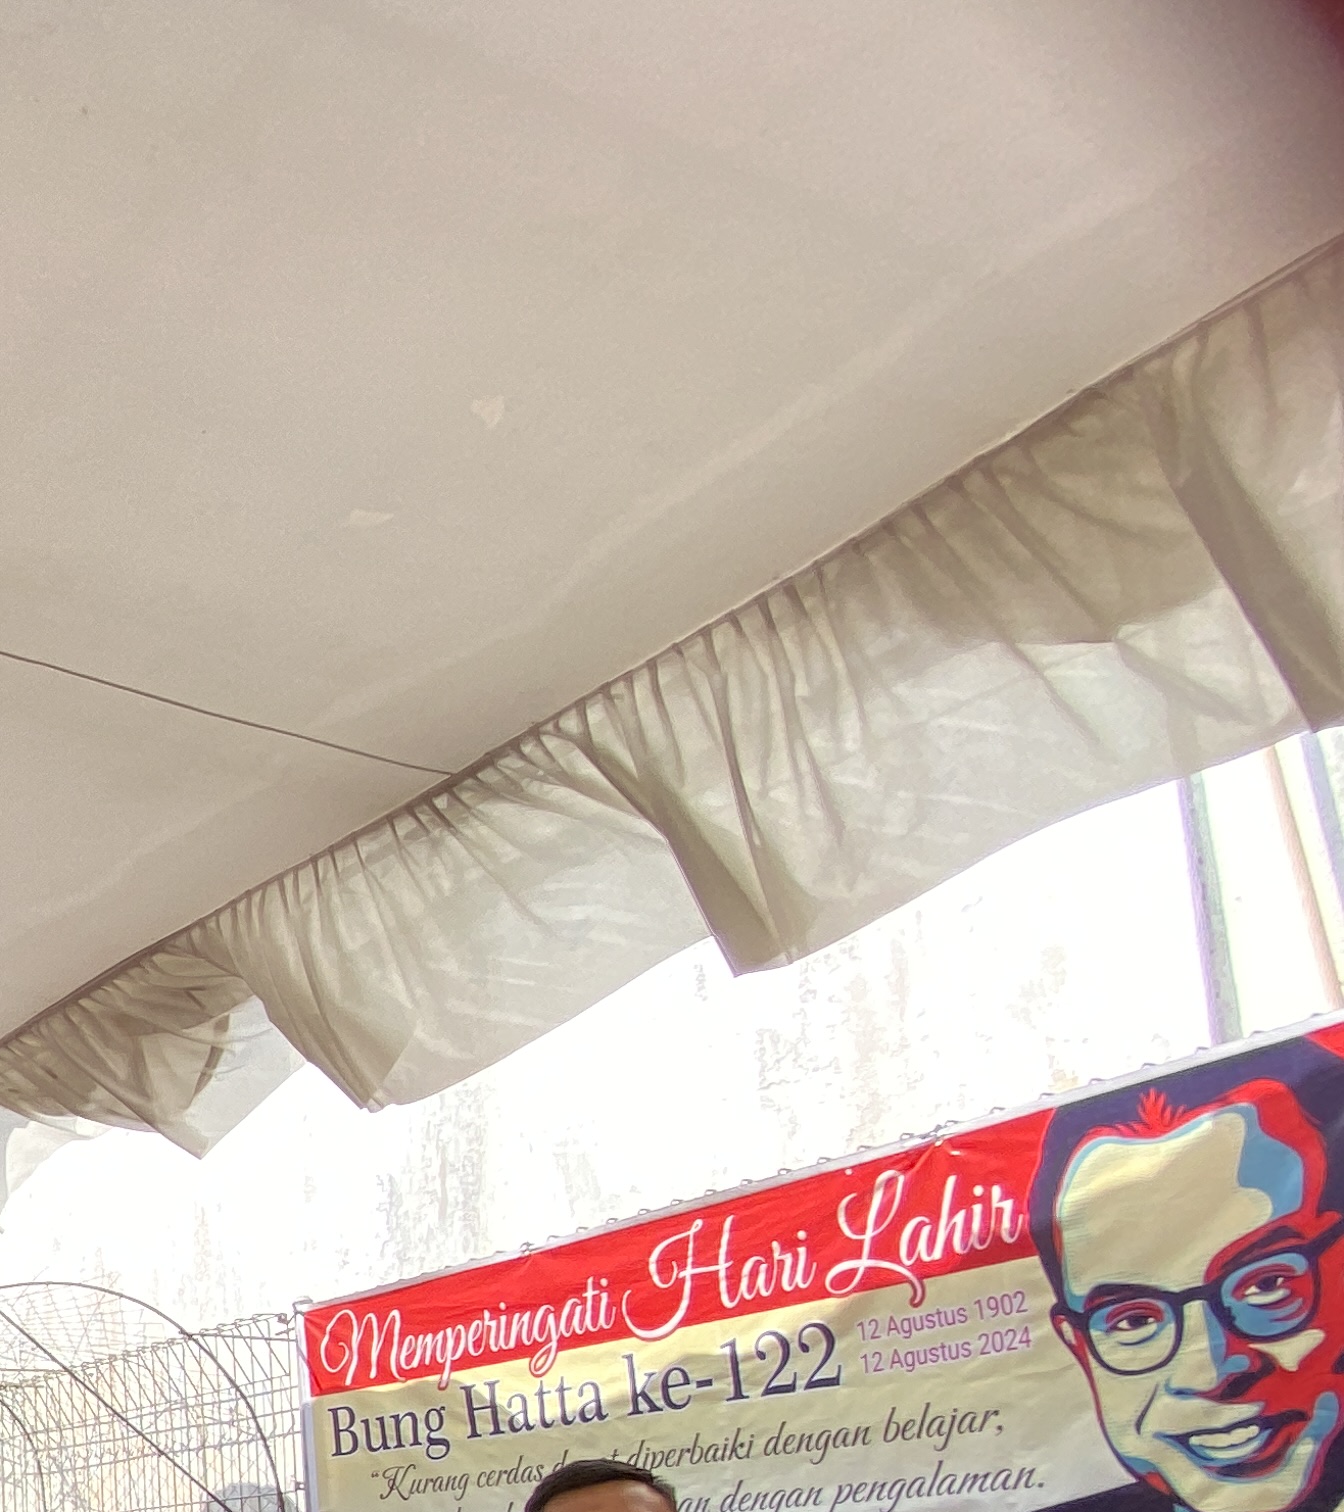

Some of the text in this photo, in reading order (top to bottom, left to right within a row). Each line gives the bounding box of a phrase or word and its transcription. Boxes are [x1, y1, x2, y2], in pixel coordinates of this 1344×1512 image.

[320, 1169, 1025, 1390] Memperingati Hari Lahir
[856, 1290, 1029, 1342] 12 Agustus 1902
[327, 1322, 842, 1460] Bung Hatta ke-122
[860, 1325, 1032, 1374] 12 Agustus 2024
[477, 1454, 544, 1486] cerdas
[763, 1420, 872, 1465] dengan
[883, 1402, 1004, 1451] belajar,
